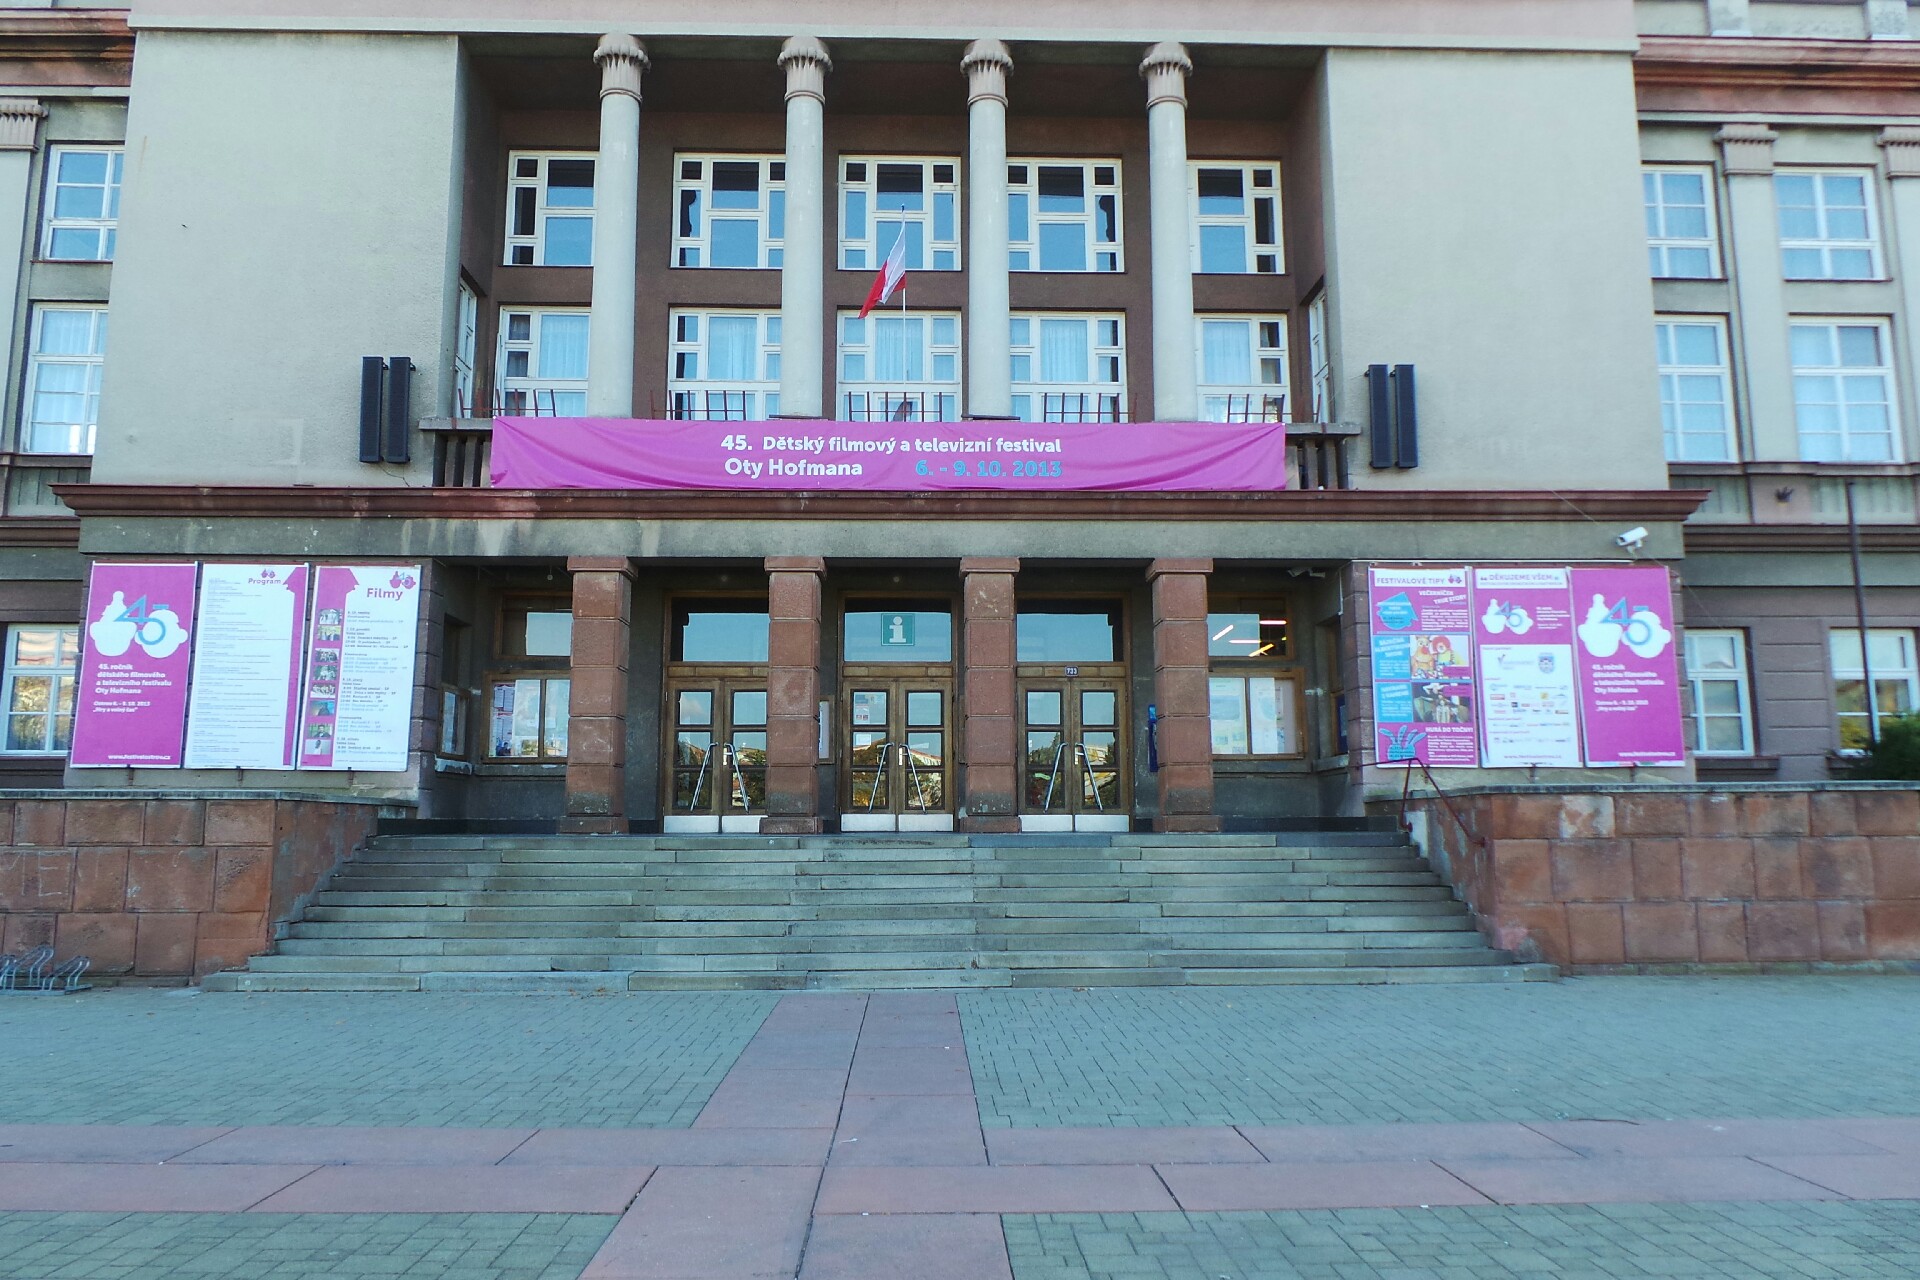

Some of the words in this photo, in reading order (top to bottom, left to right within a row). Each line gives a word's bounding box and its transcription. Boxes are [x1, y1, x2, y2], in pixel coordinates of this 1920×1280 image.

[720, 435, 753, 451] 45.
[763, 436, 825, 455] Dětský
[828, 436, 897, 455] filmový
[900, 440, 910, 452] a
[914, 437, 993, 453] televizní
[996, 437, 1062, 453] festival
[724, 457, 763, 479] Oty
[768, 458, 863, 476] Hofmana
[915, 460, 934, 476] 6.
[953, 460, 972, 477] 9.
[977, 460, 1007, 477] 10.
[1012, 460, 1063, 478] 2013
[1376, 576, 1426, 584] FESTIVALOVÉ
[1531, 573, 1552, 581] VŠEM
[366, 587, 403, 601] Filmy
